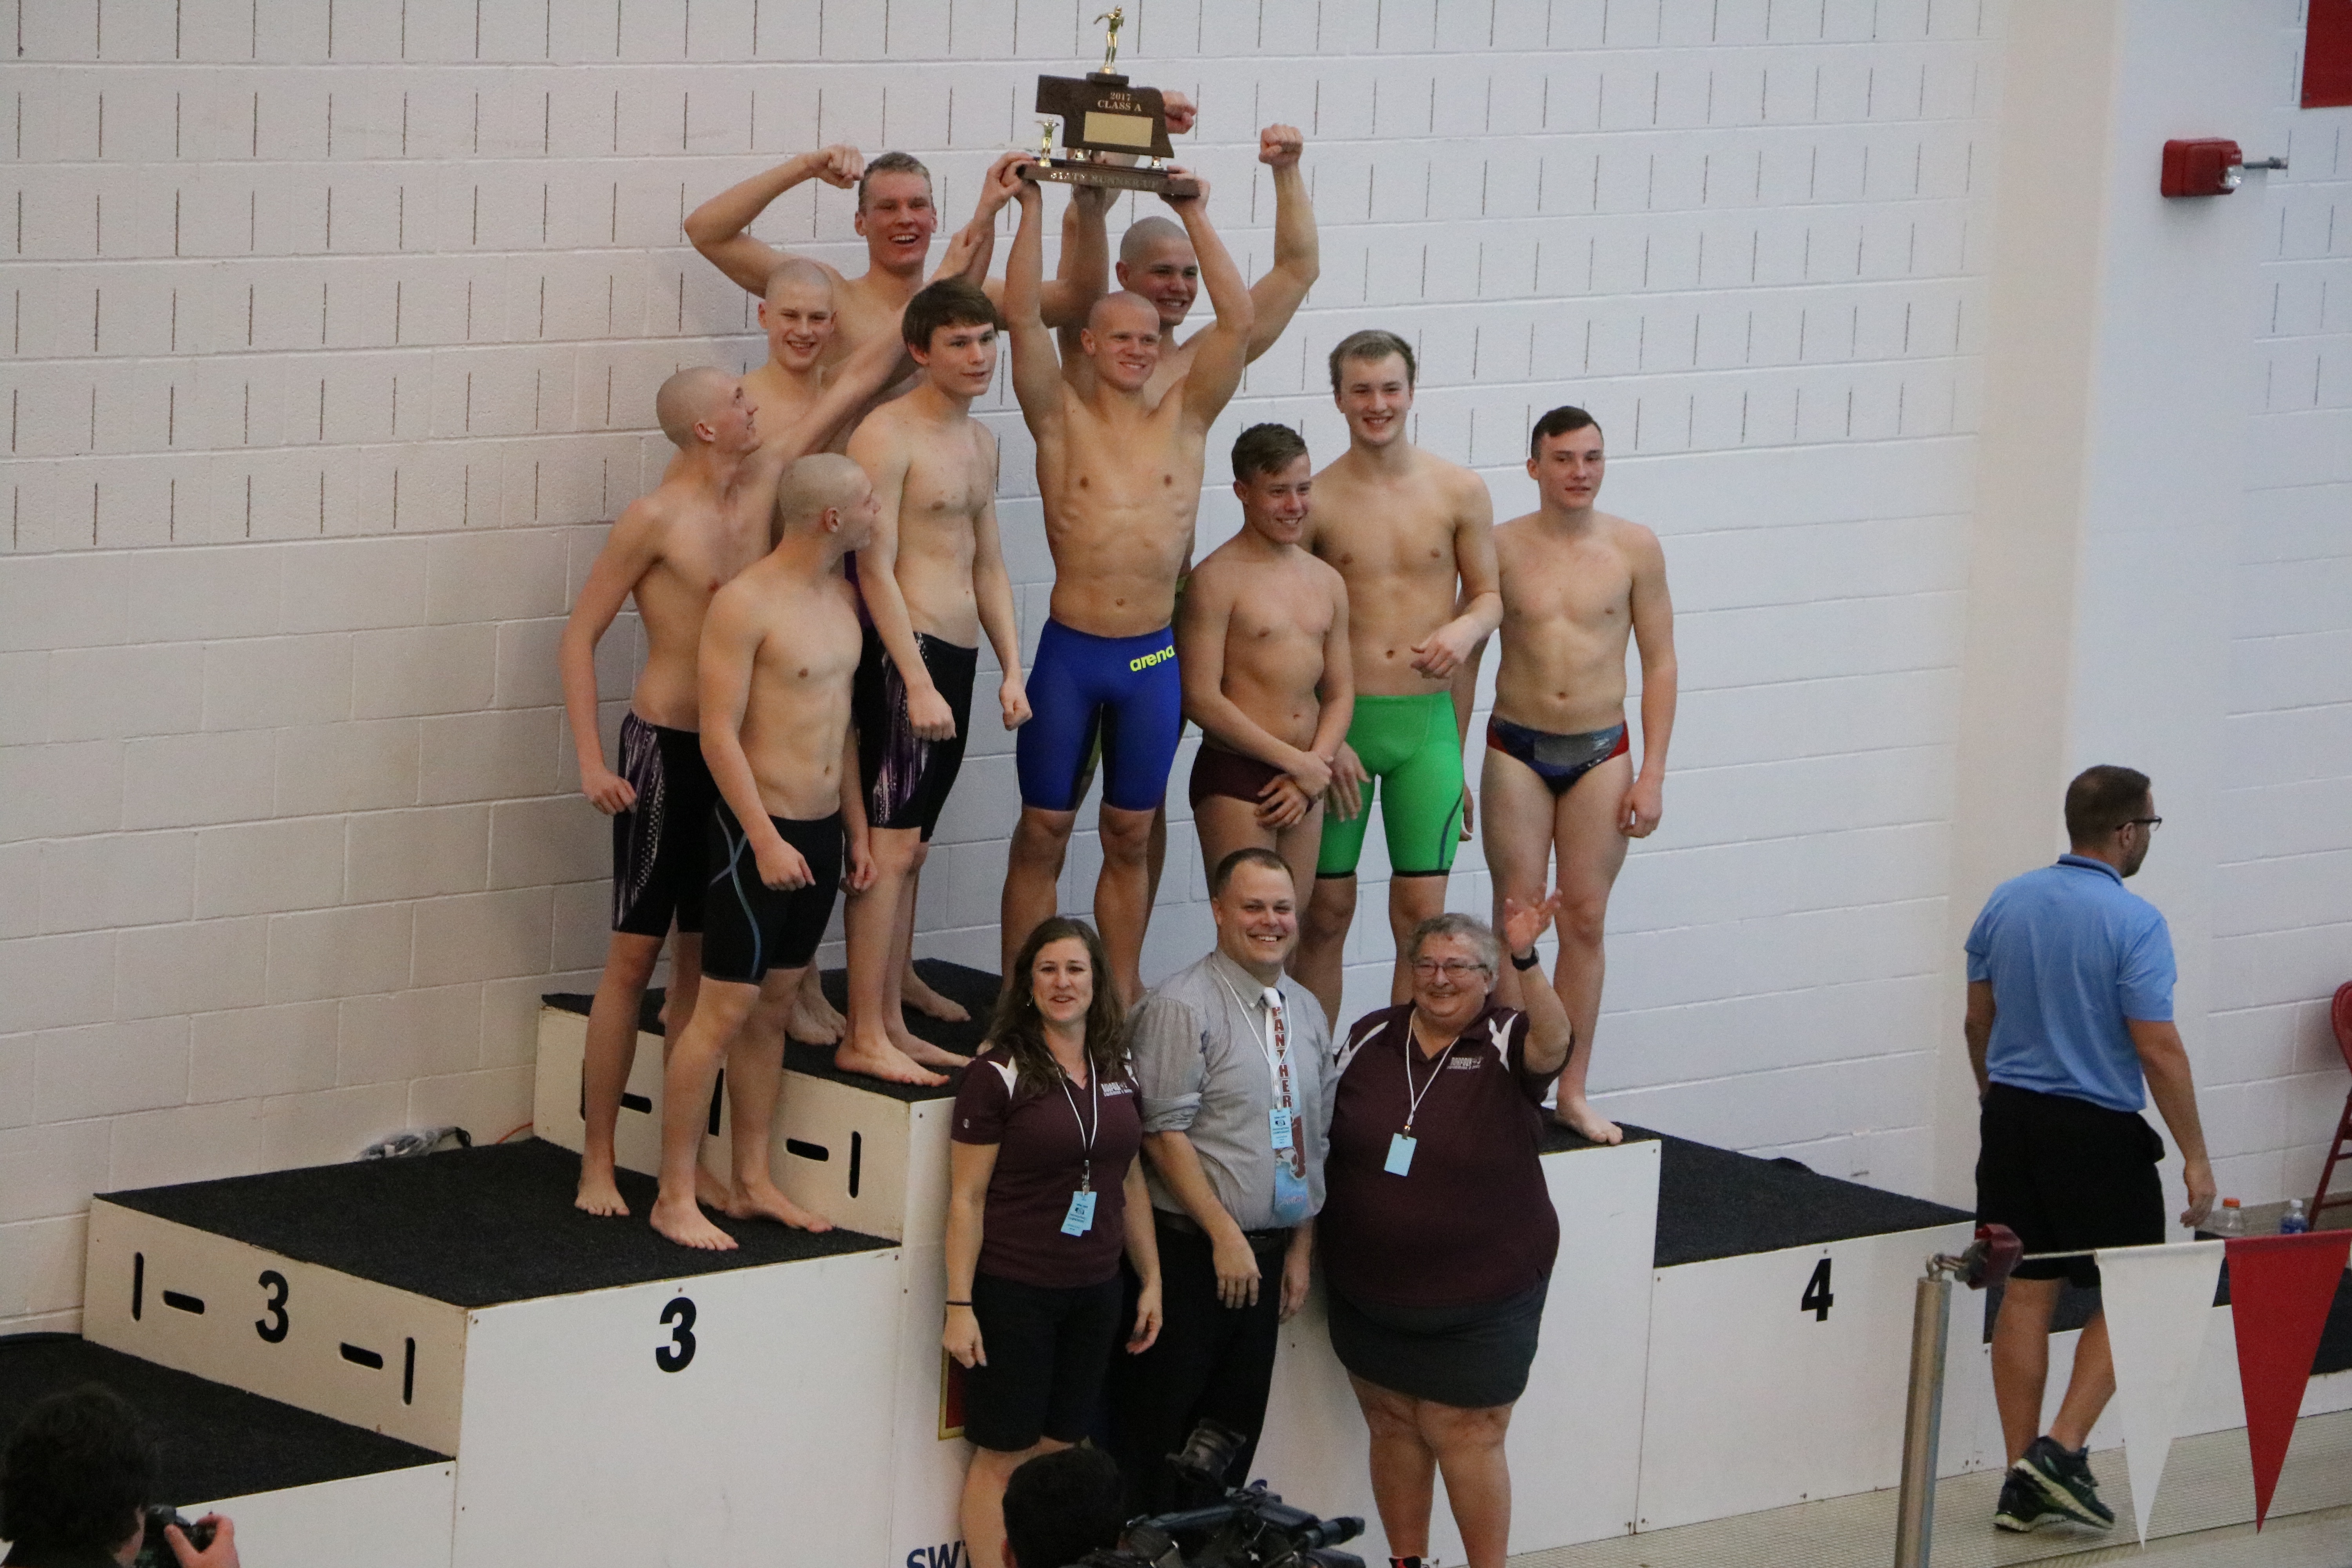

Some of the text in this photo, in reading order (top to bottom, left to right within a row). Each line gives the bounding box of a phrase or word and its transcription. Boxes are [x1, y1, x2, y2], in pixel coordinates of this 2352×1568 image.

[1097, 100, 1142, 112] CLASS A
[1110, 92, 1131, 101] 2017
[1130, 644, 1176, 672] arena
[255, 1270, 289, 1344] 3
[1801, 1258, 1835, 1322] 4
[655, 1296, 697, 1373] 3
